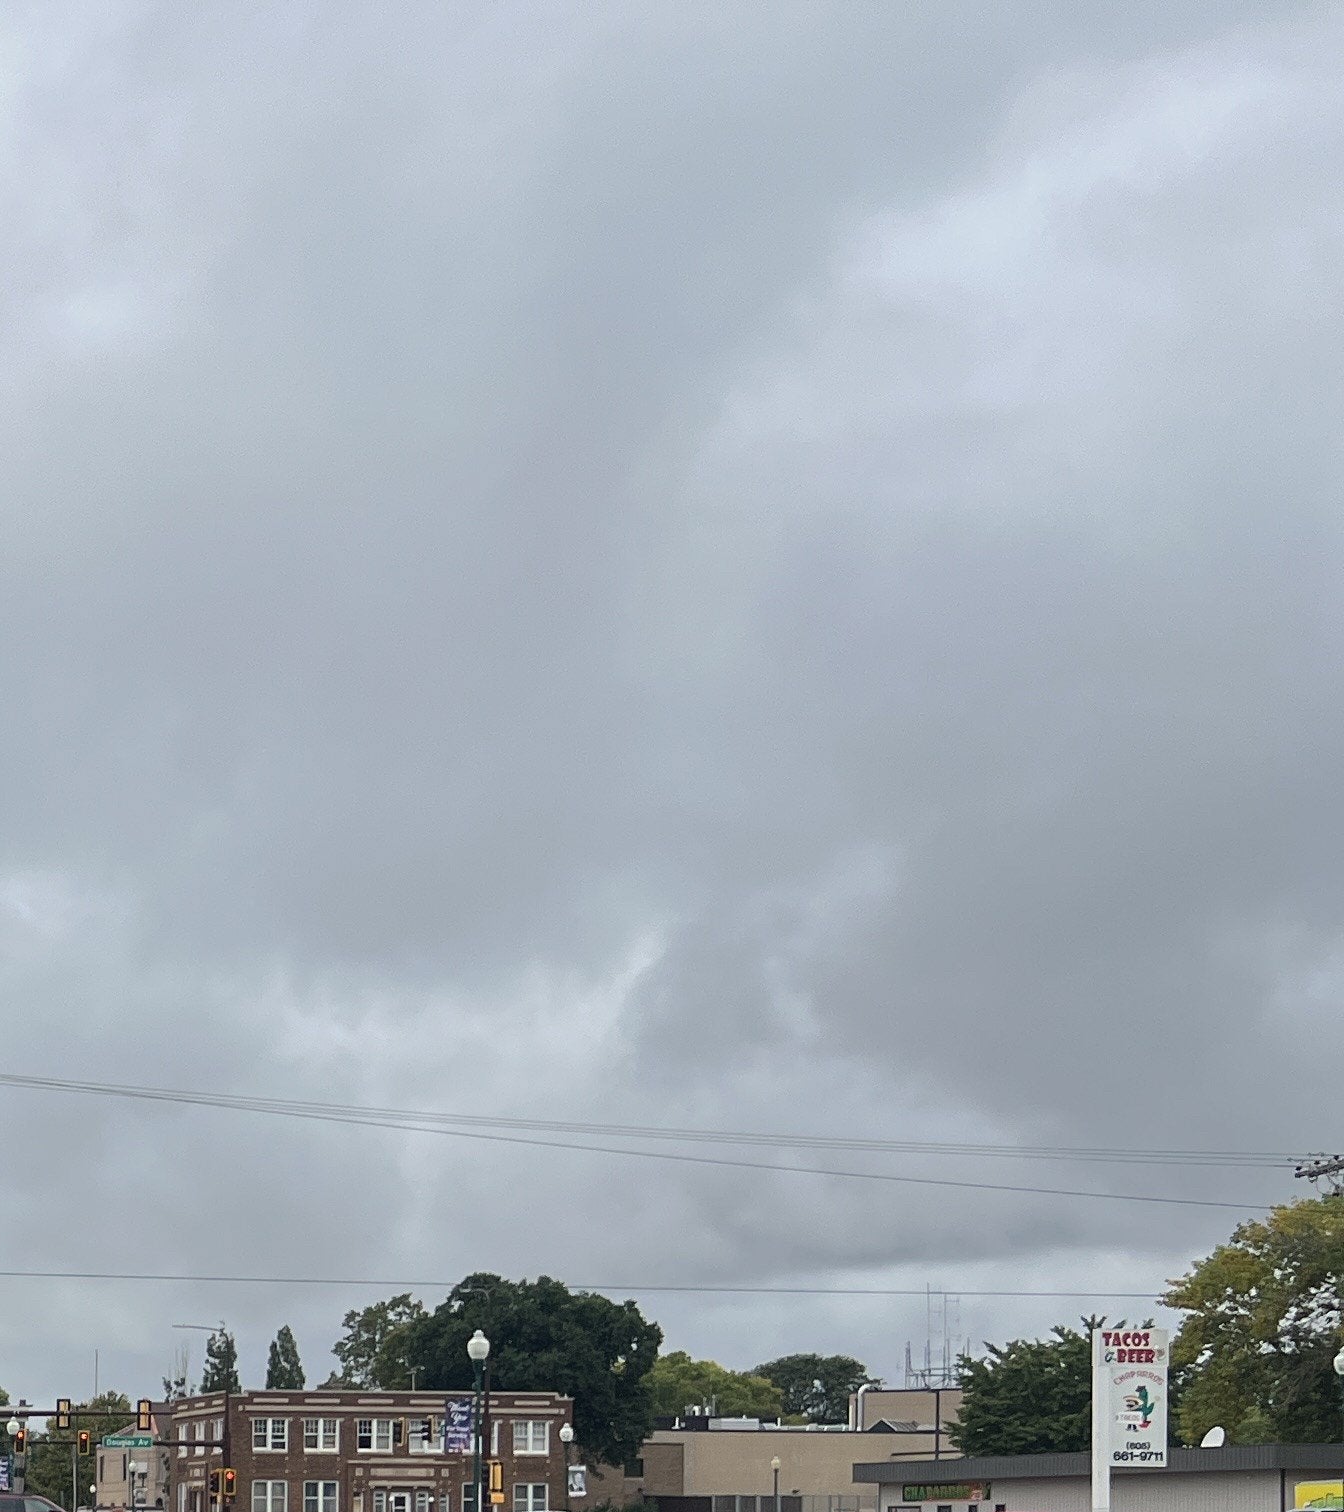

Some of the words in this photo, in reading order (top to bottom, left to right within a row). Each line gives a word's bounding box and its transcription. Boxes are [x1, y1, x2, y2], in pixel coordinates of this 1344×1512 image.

[1102, 1332, 1150, 1347] TACOS
[1117, 1348, 1156, 1363] BEER
[1113, 1451, 1164, 1461] 661-9711
